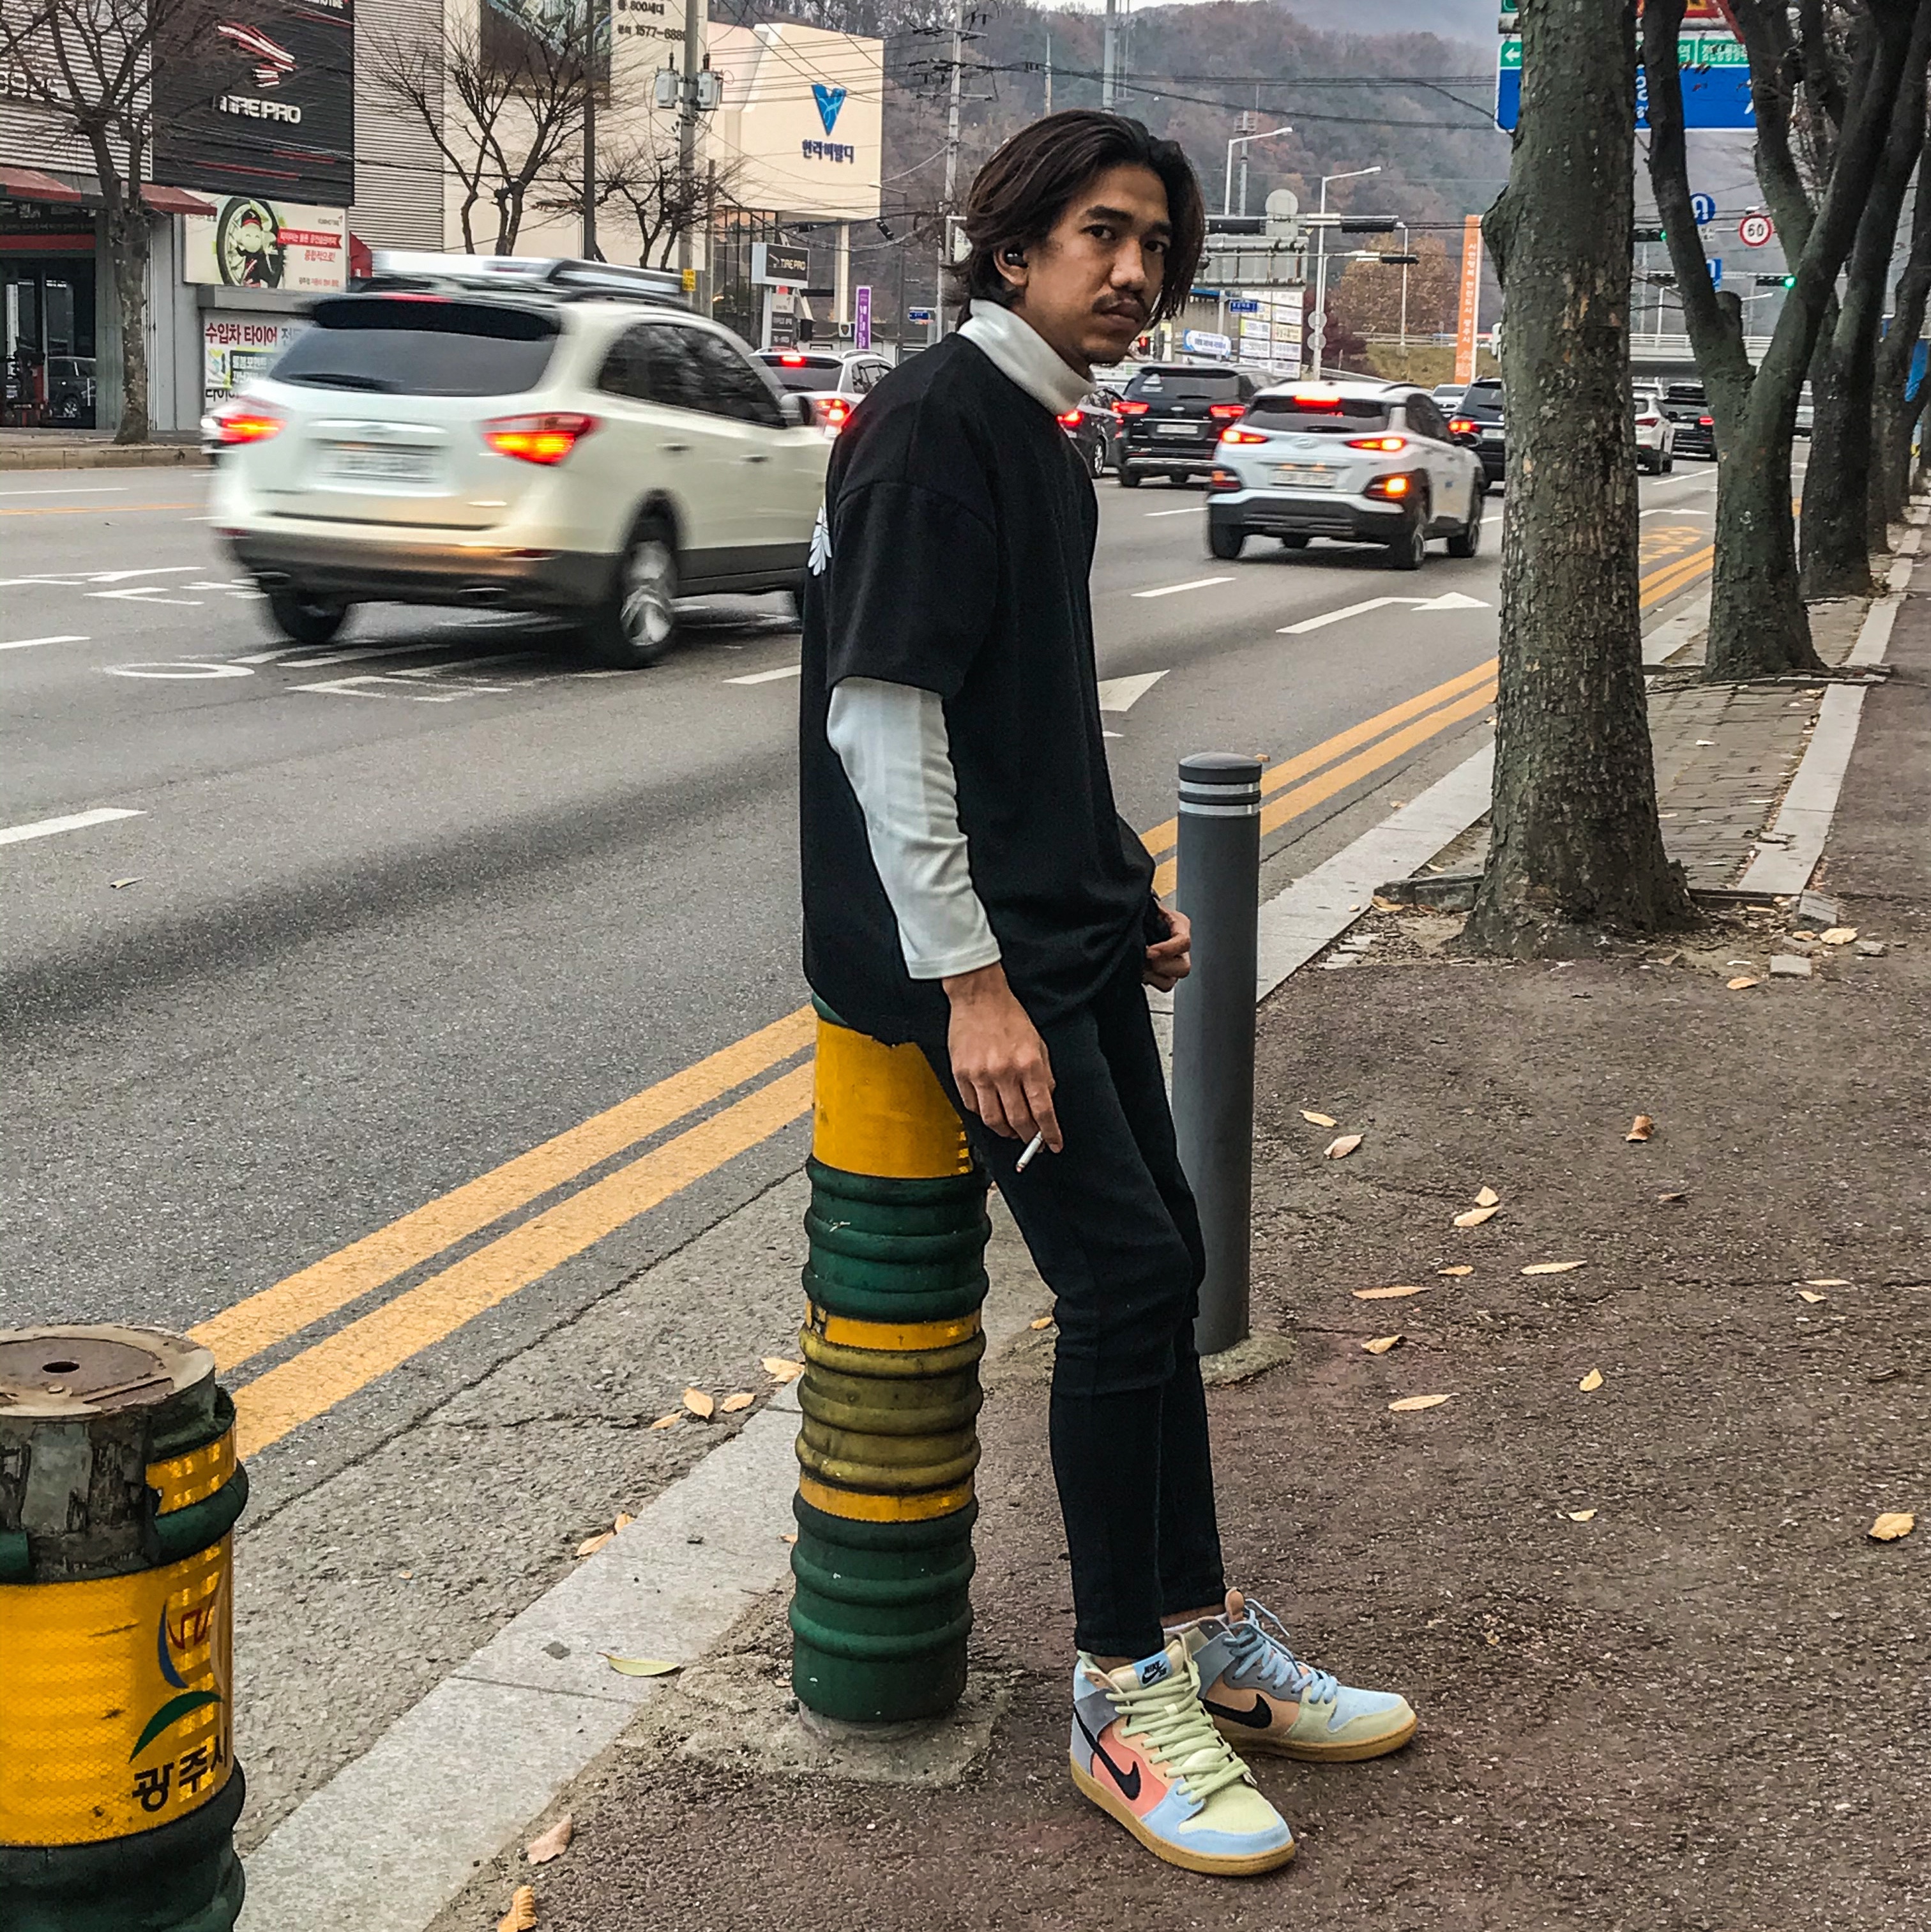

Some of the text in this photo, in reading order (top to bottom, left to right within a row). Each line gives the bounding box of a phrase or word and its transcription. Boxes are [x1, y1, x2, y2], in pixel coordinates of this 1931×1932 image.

[630, 0, 664, 15] 800세대
[802, 139, 854, 165] 한라비발디
[1748, 223, 1764, 237] 60
[205, 323, 241, 345] 수입차
[244, 324, 278, 346] 타이어
[132, 1726, 228, 1812] 광주시
